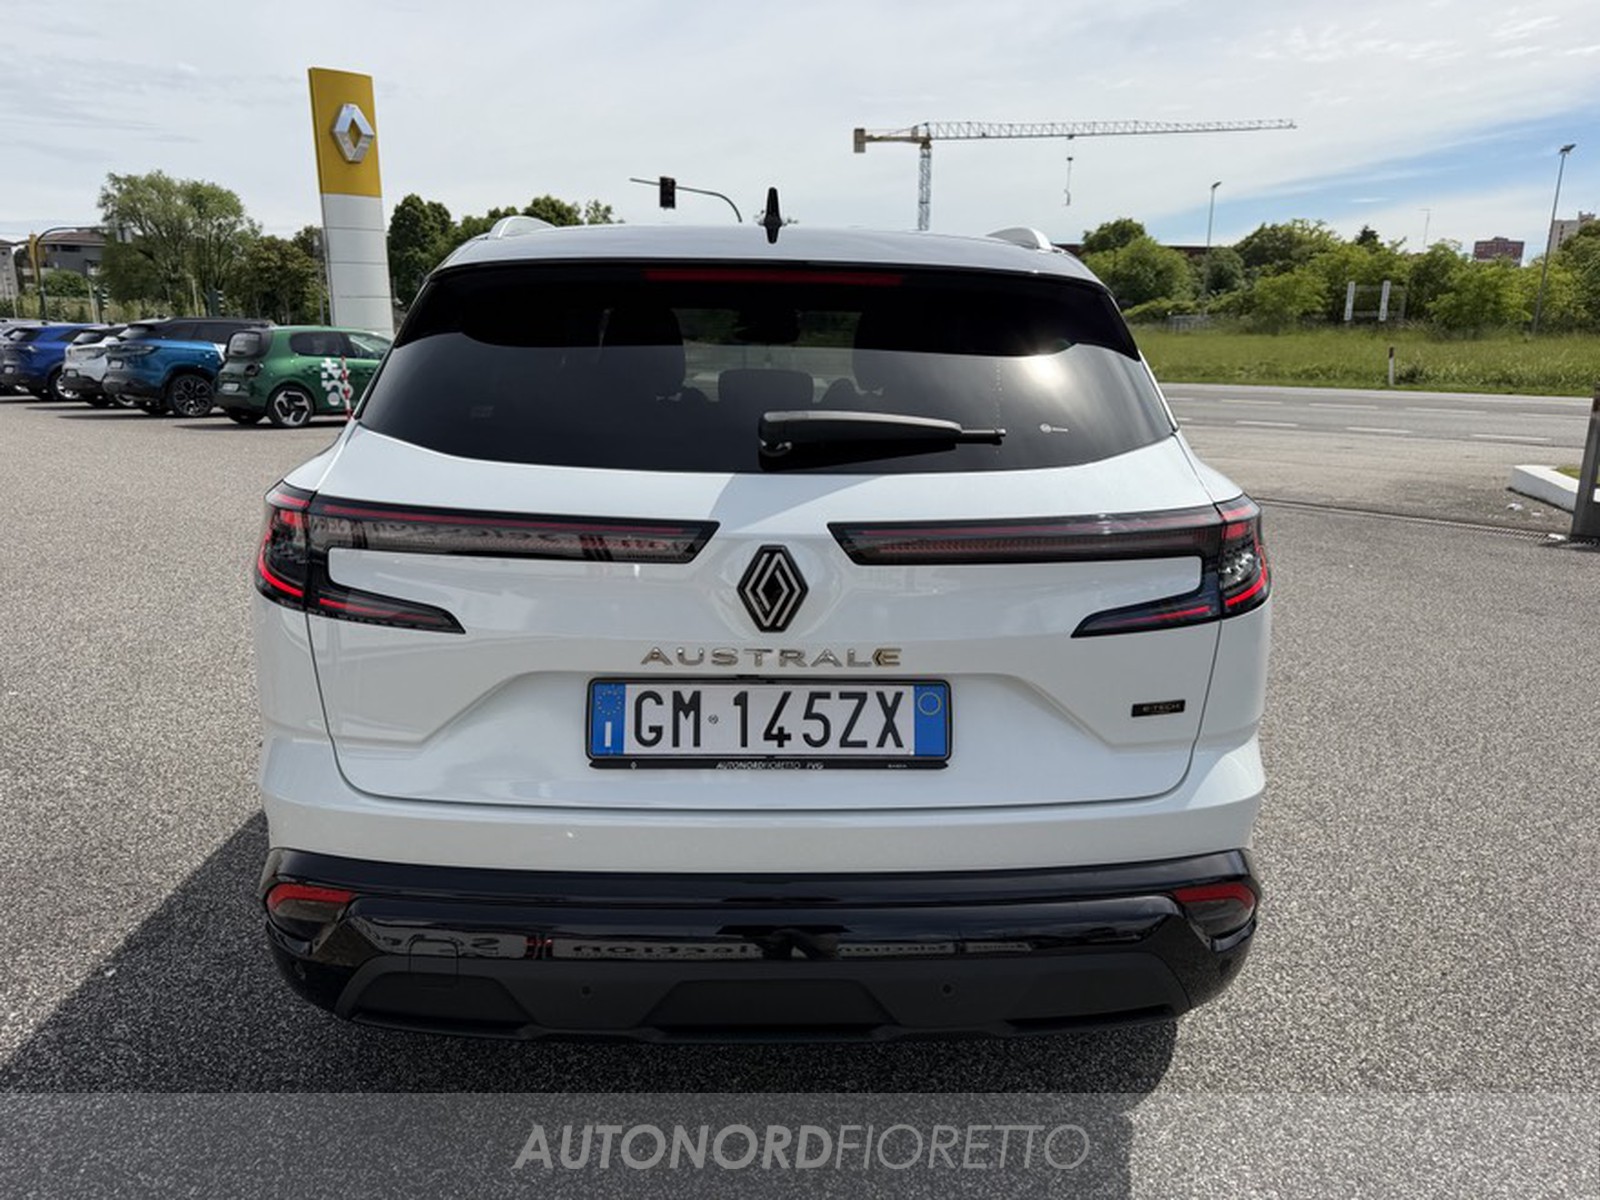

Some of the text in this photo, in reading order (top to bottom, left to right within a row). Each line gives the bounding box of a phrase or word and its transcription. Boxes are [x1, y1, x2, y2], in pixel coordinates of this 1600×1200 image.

[641, 648, 902, 667] AUSTRALE
[634, 690, 904, 748] GM 145ZX
